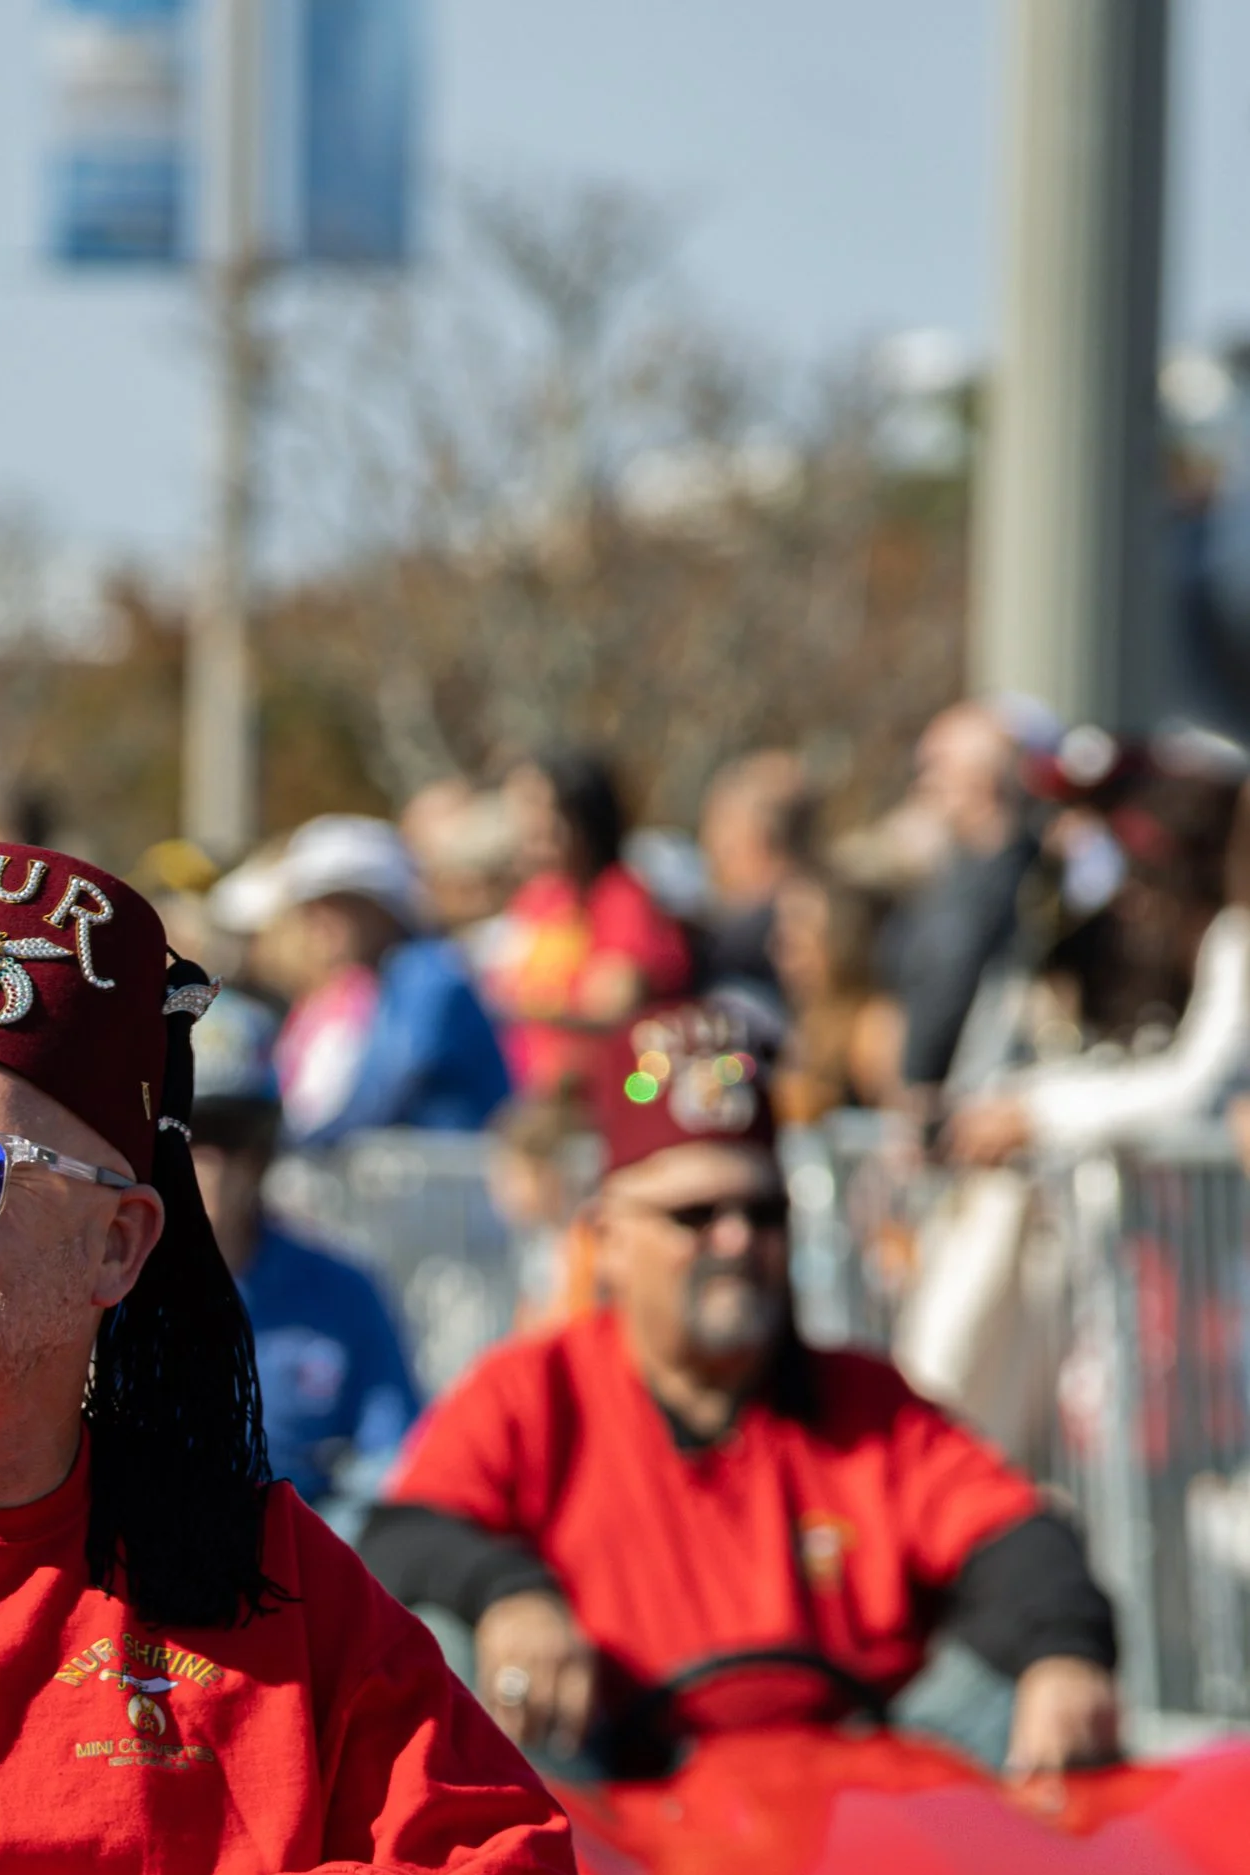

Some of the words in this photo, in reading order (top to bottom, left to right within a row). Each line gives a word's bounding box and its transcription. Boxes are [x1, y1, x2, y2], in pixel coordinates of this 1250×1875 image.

[54, 1637, 120, 1688] NUR
[121, 1633, 225, 1688] SHRINE
[75, 1739, 114, 1758] MINI
